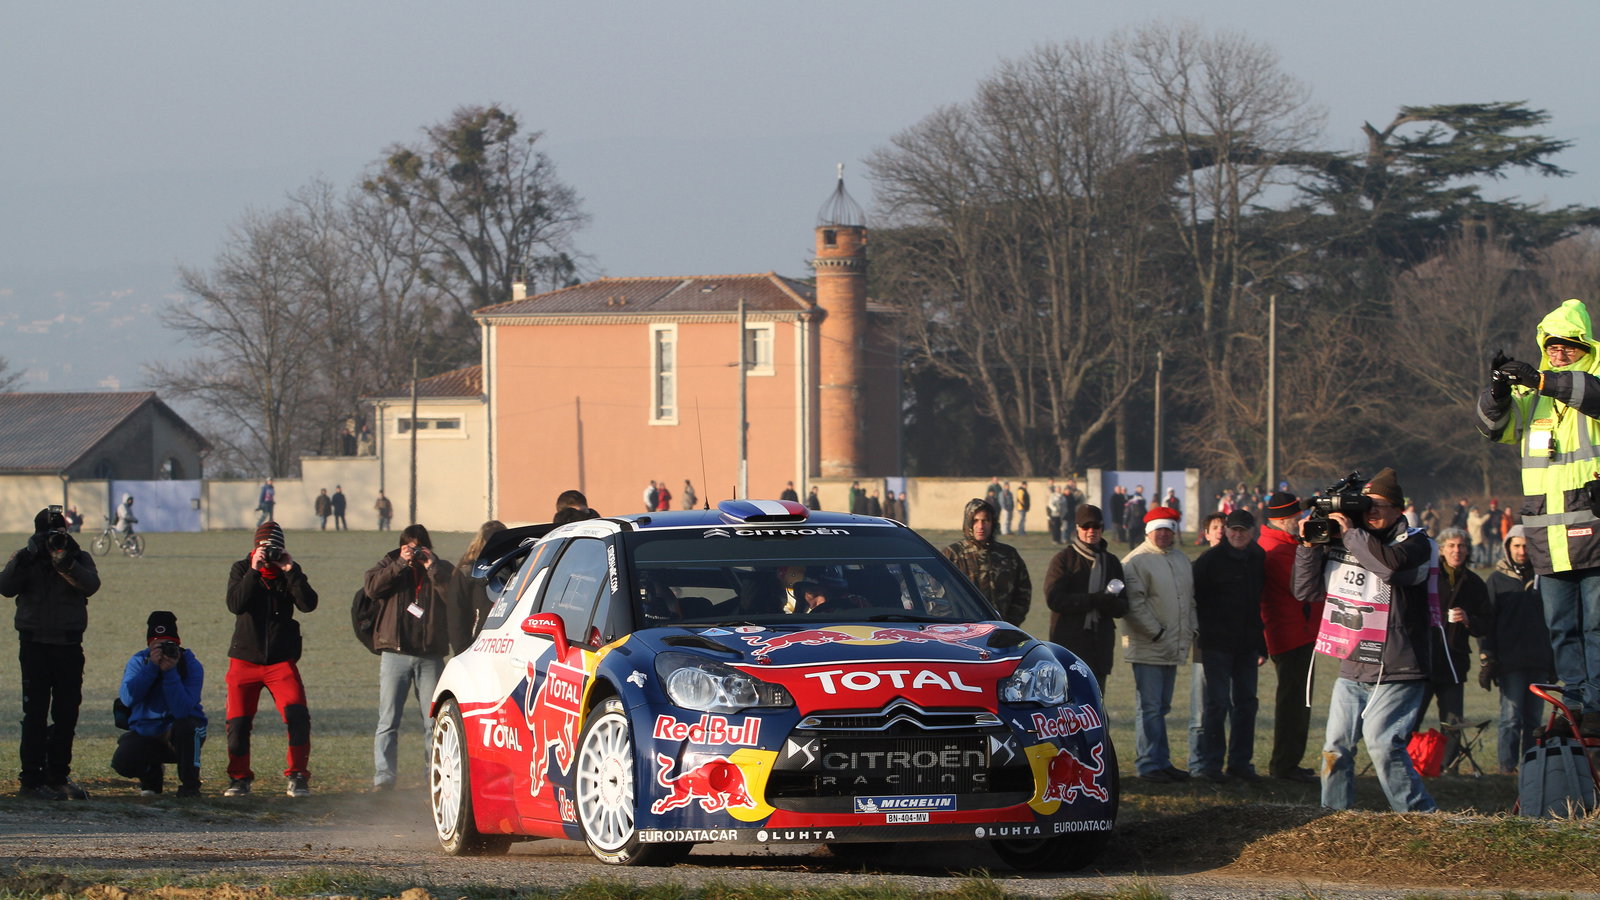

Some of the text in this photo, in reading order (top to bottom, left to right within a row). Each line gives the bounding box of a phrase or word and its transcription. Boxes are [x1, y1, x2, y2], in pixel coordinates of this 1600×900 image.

[735, 527, 850, 536] CITROËN
[1344, 569, 1365, 586] 428
[528, 619, 557, 627] TOTAL
[549, 672, 580, 705] TOTAL
[804, 670, 983, 694] TOTAL
[1031, 704, 1101, 740] Red Bull
[479, 718, 522, 752] TOTAL
[653, 714, 761, 746] Red Bull
[823, 744, 986, 770] CITROËN
[822, 773, 986, 785] RACING
[880, 798, 952, 808] MICHELIN
[888, 814, 927, 823] BN-404-MV
[638, 829, 738, 842] EURODATACAR
[772, 831, 836, 840] LUHTA
[989, 826, 1041, 836] LUHTA
